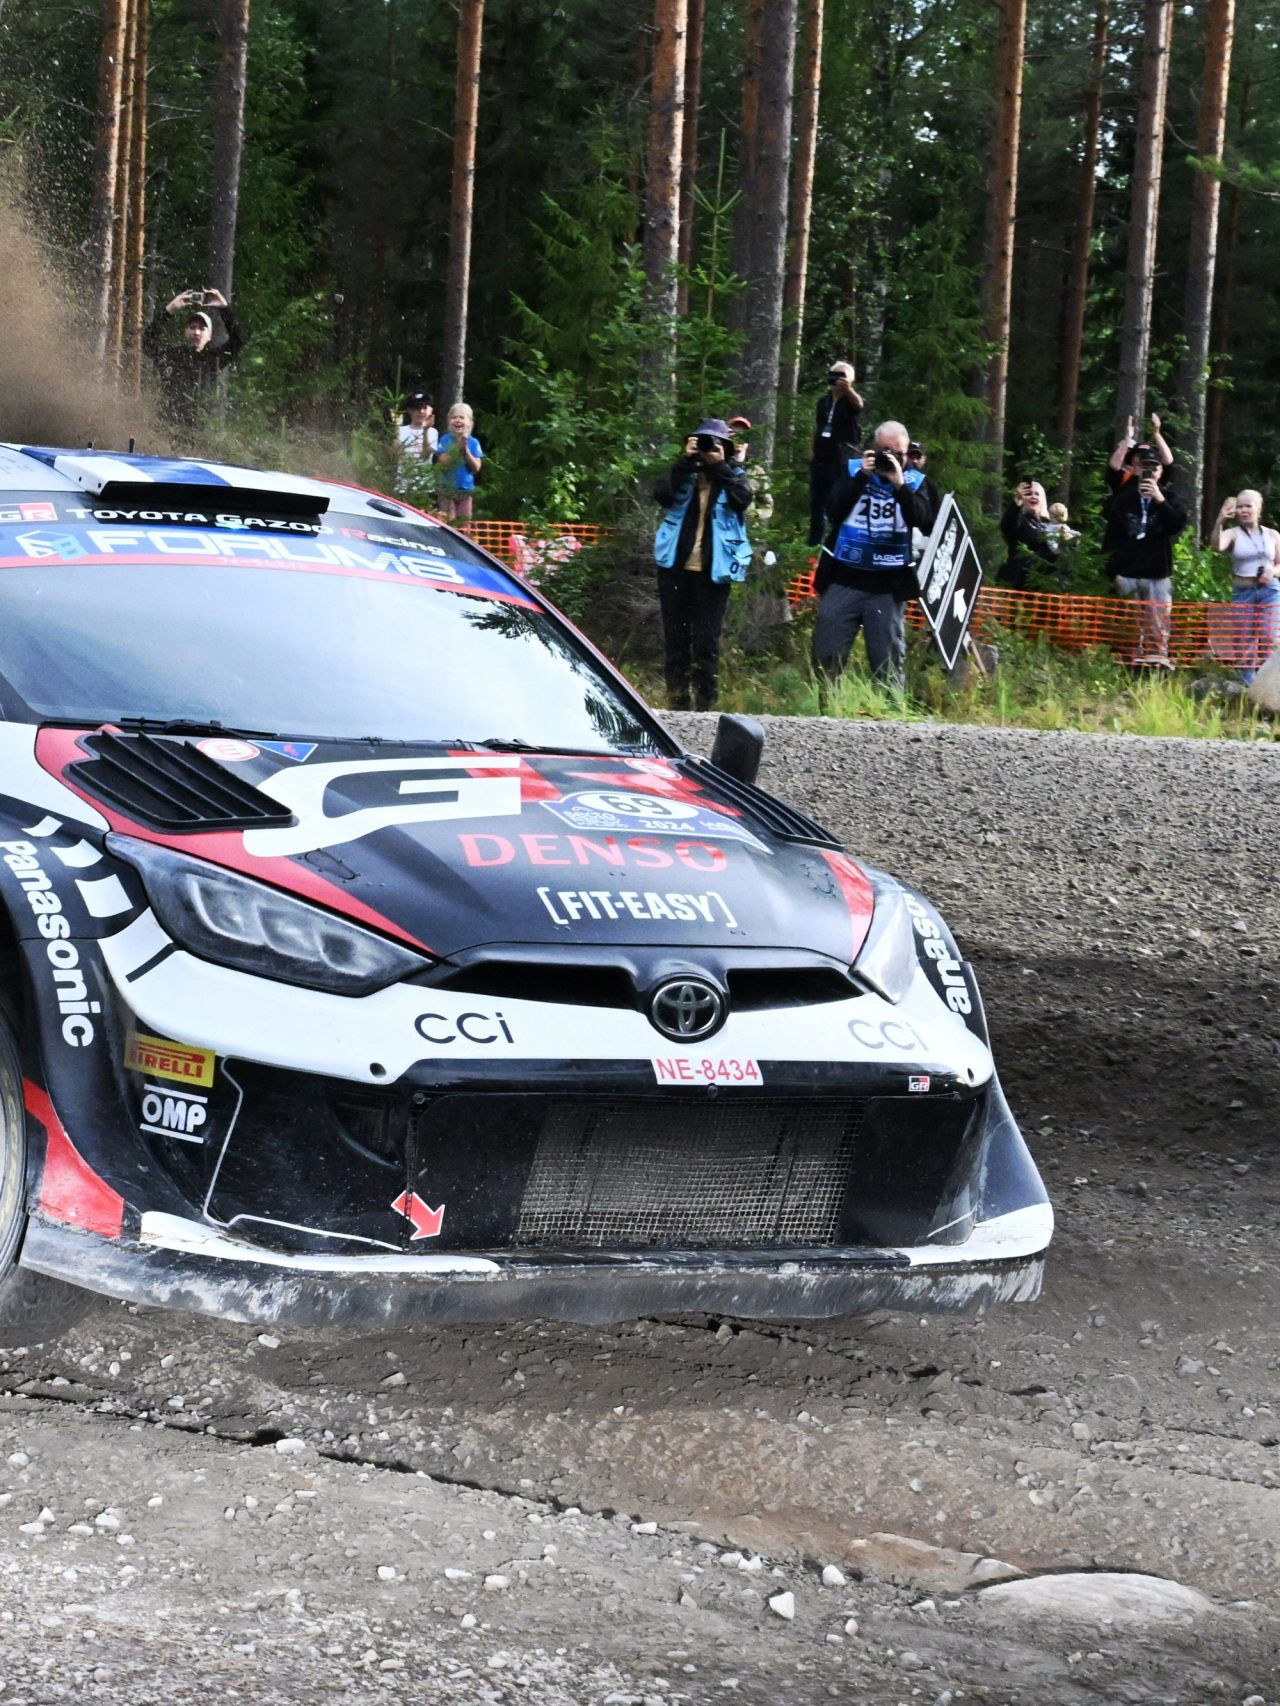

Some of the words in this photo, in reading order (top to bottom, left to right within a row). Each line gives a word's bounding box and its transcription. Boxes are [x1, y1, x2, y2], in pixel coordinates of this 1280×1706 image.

[66, 508, 207, 522] TOYOTA
[216, 514, 334, 535] GAZOO
[340, 527, 446, 556] Racing
[86, 530, 466, 584] FORUM8
[599, 795, 673, 816] 69
[639, 819, 696, 832] 2024
[457, 833, 728, 873] DENSO
[656, 1058, 759, 1081] NE-8434
[141, 1093, 207, 1133] OMP
